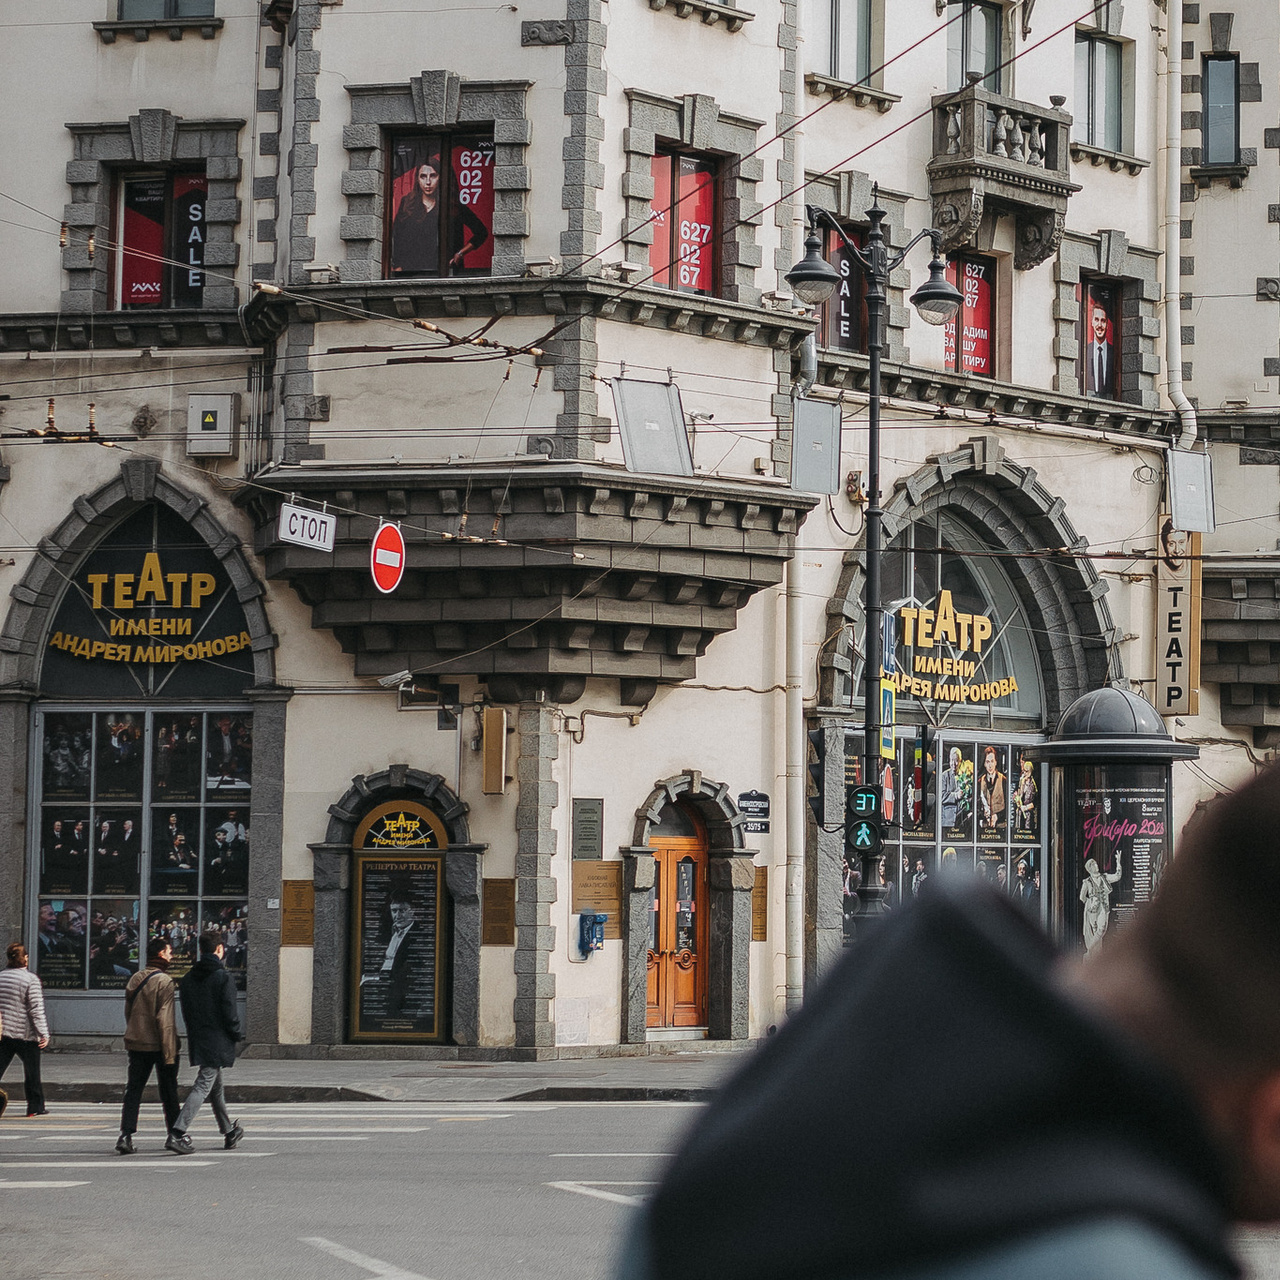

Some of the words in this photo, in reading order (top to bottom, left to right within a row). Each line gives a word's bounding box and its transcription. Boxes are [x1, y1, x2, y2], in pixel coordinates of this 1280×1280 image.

[460, 151, 494, 167] 627
[460, 170, 482, 186] 02
[459, 188, 481, 205] 67
[680, 221, 711, 243] 627
[188, 204, 202, 287] SALE
[680, 243, 700, 264] 02
[680, 265, 700, 286] 67
[965, 263, 985, 279] 627
[965, 279, 979, 294] 02
[840, 260, 850, 338] SALE
[965, 293, 979, 308] 67
[288, 512, 328, 544] СТОП
[87, 552, 216, 609] ТЕАТР
[110, 618, 191, 636] ИМЕНИ
[901, 589, 992, 653] ТЕАТР
[50, 631, 130, 661] АНДРЕЯ
[134, 631, 252, 663] МИРОНОВА
[1165, 586, 1183, 707] ТЕАТР
[915, 655, 975, 677] ИМЕНИ
[934, 676, 1019, 702] МИРОНОВА
[856, 793, 875, 810] 37
[384, 813, 420, 831] ТЕАТР
[365, 863, 407, 871] РЕПЕРТУАР
[408, 863, 436, 871] ТЕАТРА
